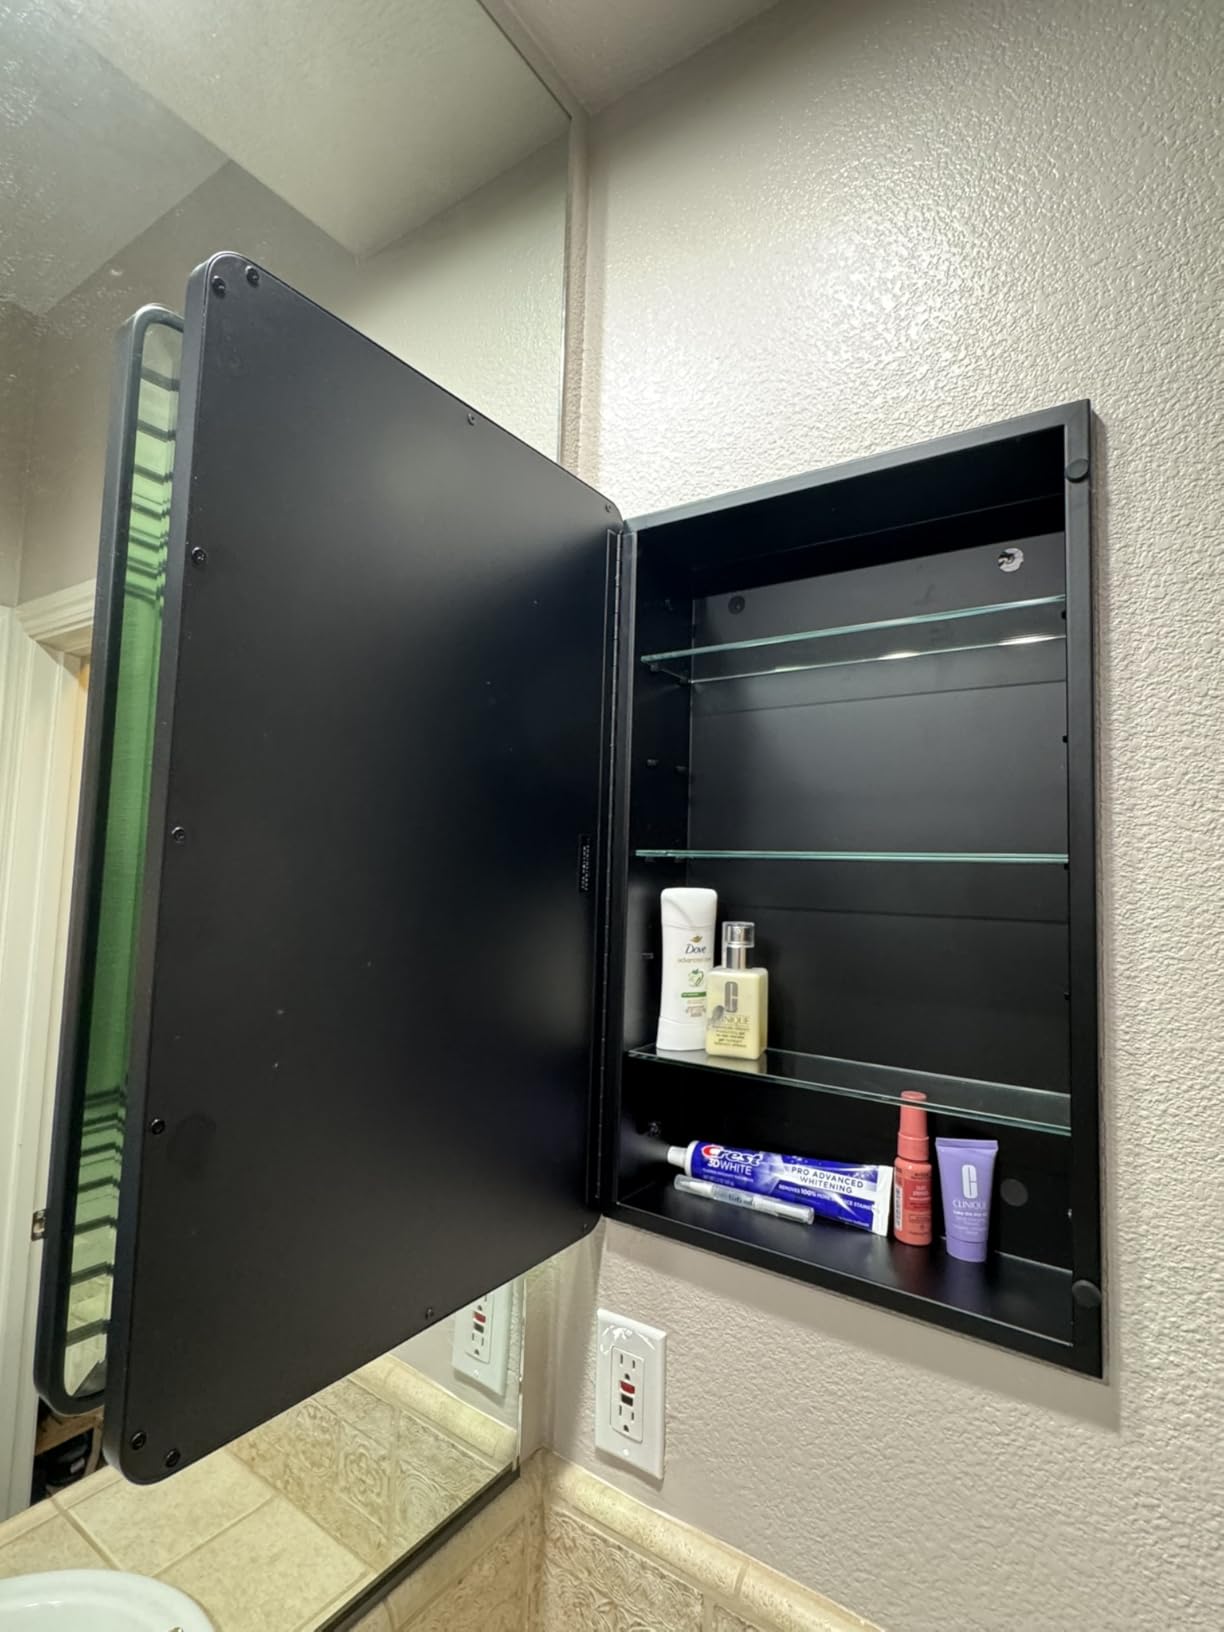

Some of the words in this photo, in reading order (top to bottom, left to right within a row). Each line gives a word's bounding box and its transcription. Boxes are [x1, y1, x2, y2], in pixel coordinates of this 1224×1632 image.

[685, 943, 706, 954] Dove
[701, 1144, 763, 1166] Crest
[720, 1160, 753, 1176] WHITE
[791, 1166, 810, 1176] PRO
[812, 1171, 864, 1188] ADVANCED
[799, 1175, 853, 1194] WHITENING
